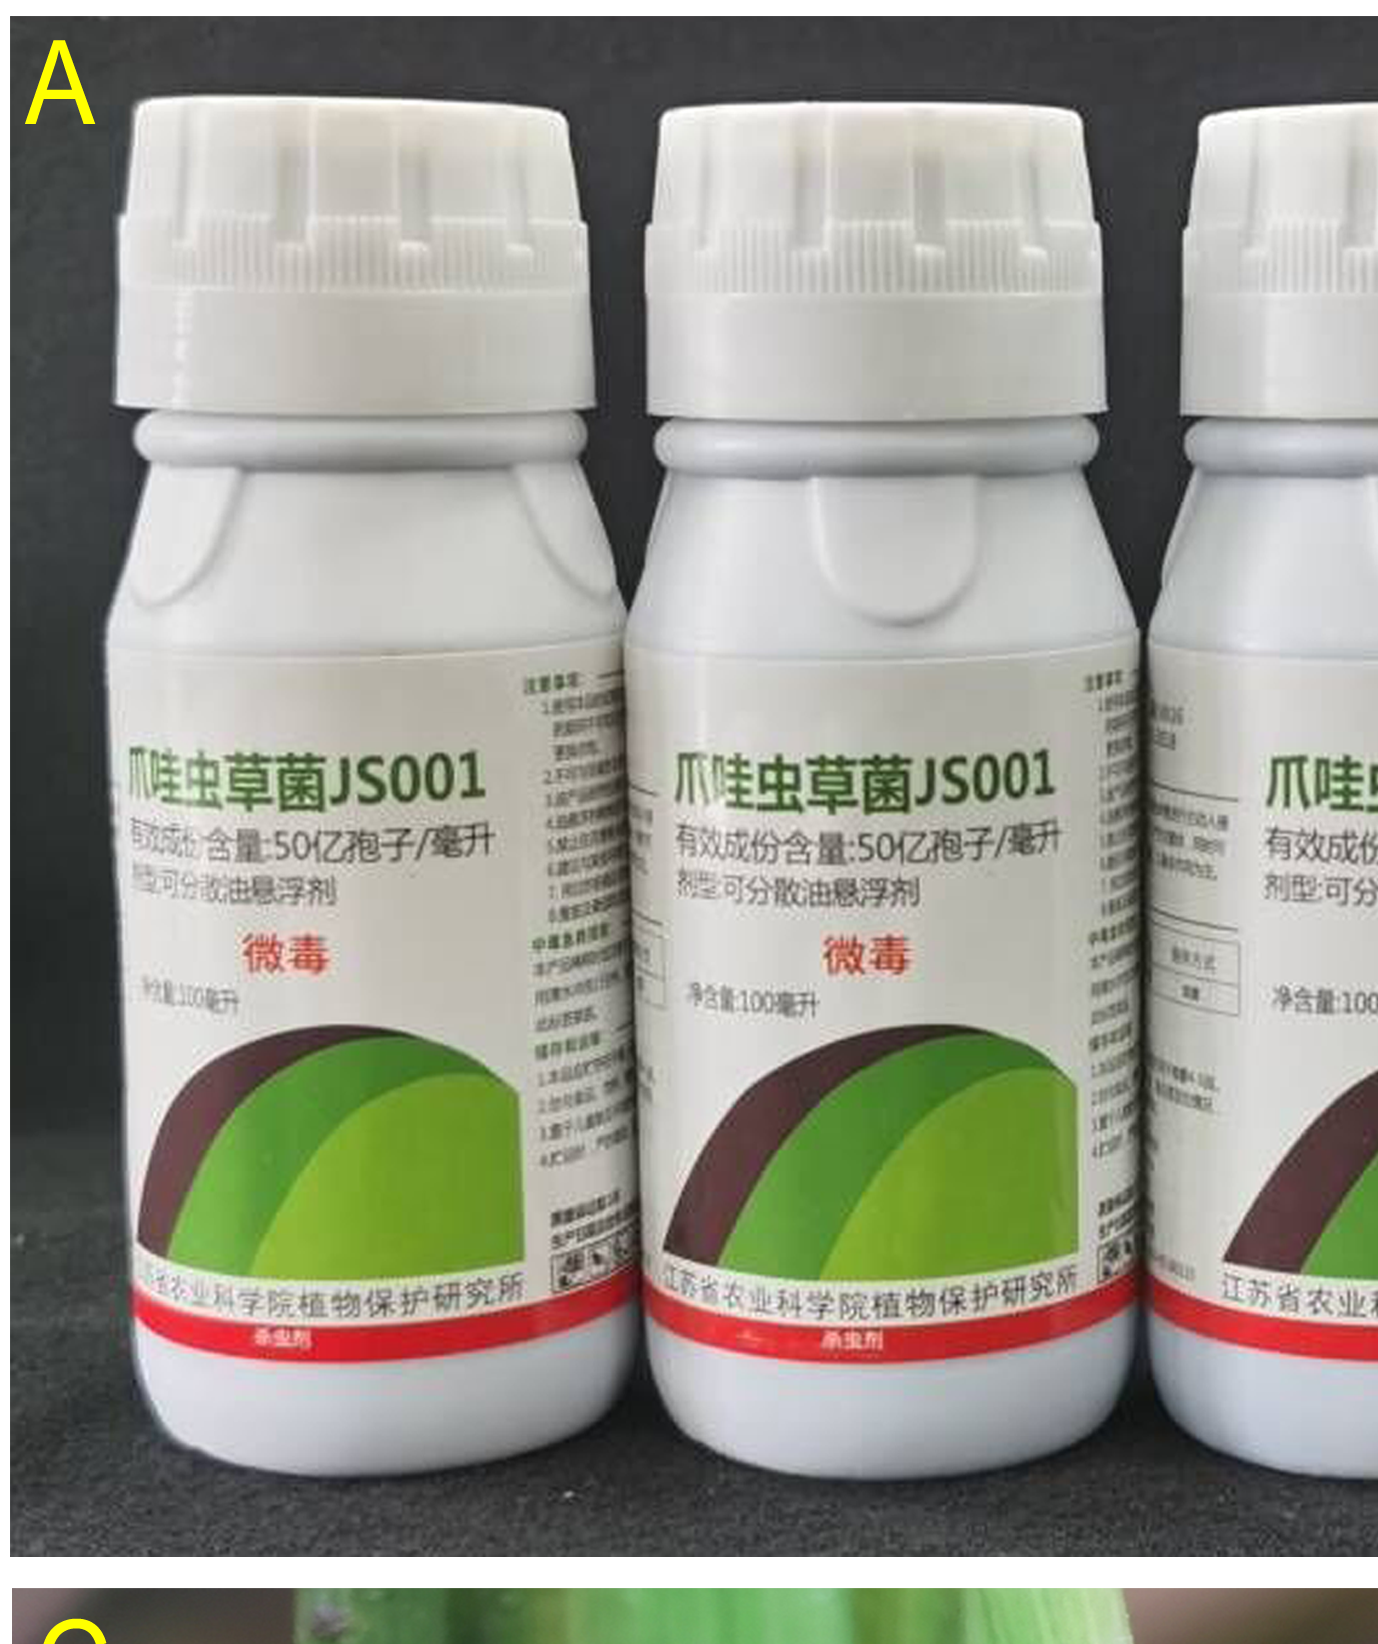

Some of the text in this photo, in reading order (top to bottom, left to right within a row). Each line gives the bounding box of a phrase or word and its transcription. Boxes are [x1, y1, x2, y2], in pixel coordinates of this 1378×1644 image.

[129, 746, 486, 814] 爪哇虫草菌JS001
[674, 748, 1057, 815] 爪哇虫草菌JS001
[242, 932, 331, 977] 微毒
[823, 933, 912, 977] 微毒
[142, 1269, 526, 1321] 省农业科学院植物保护研究所
[663, 1264, 1079, 1321] 江苏省农业科学院植物保护研究所
